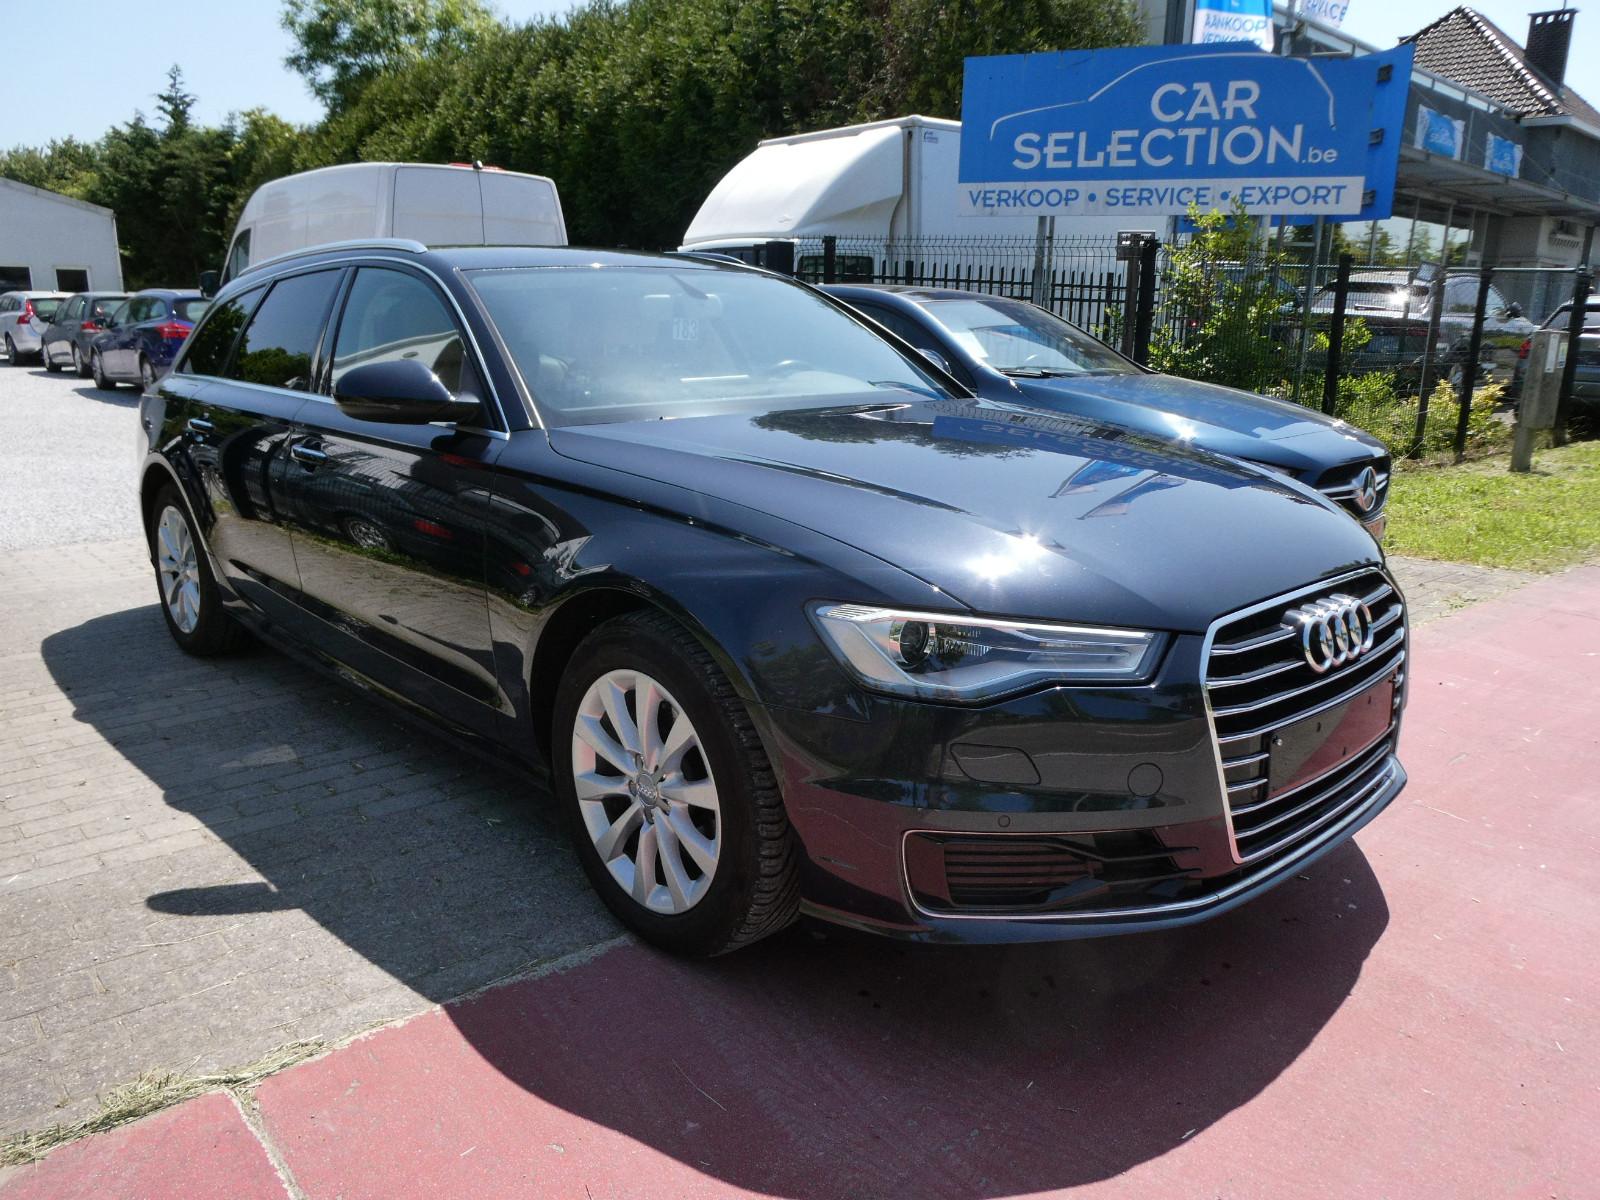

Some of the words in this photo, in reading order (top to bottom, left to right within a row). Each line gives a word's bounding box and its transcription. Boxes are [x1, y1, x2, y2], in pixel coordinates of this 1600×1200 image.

[1204, 13, 1268, 32] AANKOOP
[1150, 80, 1260, 123] CAR
[968, 188, 1080, 208] VERKOOP
[1105, 186, 1212, 207] SERVICE
[1239, 185, 1347, 207] EXPORT
